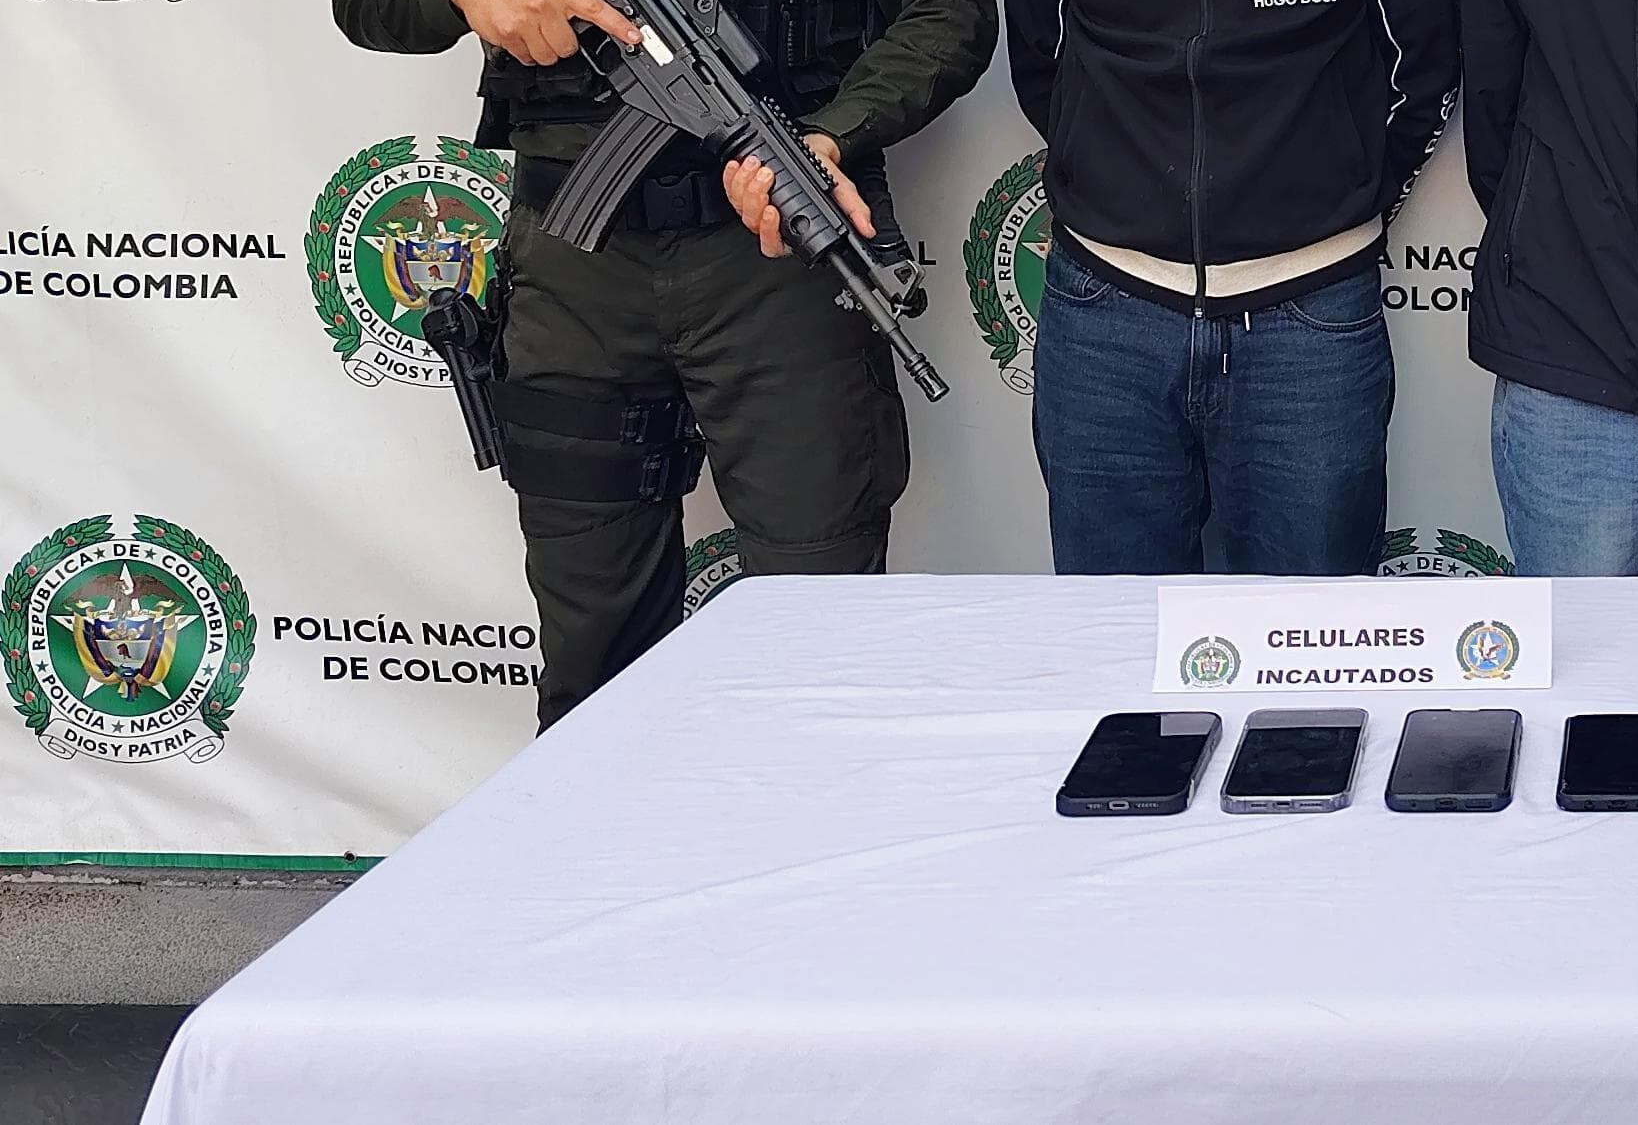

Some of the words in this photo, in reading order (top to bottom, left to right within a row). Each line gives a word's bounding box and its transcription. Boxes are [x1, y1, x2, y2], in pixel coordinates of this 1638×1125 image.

[417, 165, 444, 180] DE
[87, 234, 285, 258] NACIONAL
[44, 273, 237, 298] COLOMBIA
[1417, 557, 1444, 572] DE
[113, 543, 141, 558] DE
[162, 555, 223, 653] COLOMBIA
[274, 614, 413, 644] POLICÍA
[422, 622, 536, 649] NACIO
[1268, 629, 1424, 647] CELULARES
[324, 657, 369, 679] DE
[379, 658, 538, 686] COLOMBI
[1257, 668, 1433, 683] INCAUTADOS
[129, 675, 216, 734] NACIONAL
[130, 730, 195, 756] PATRIA
